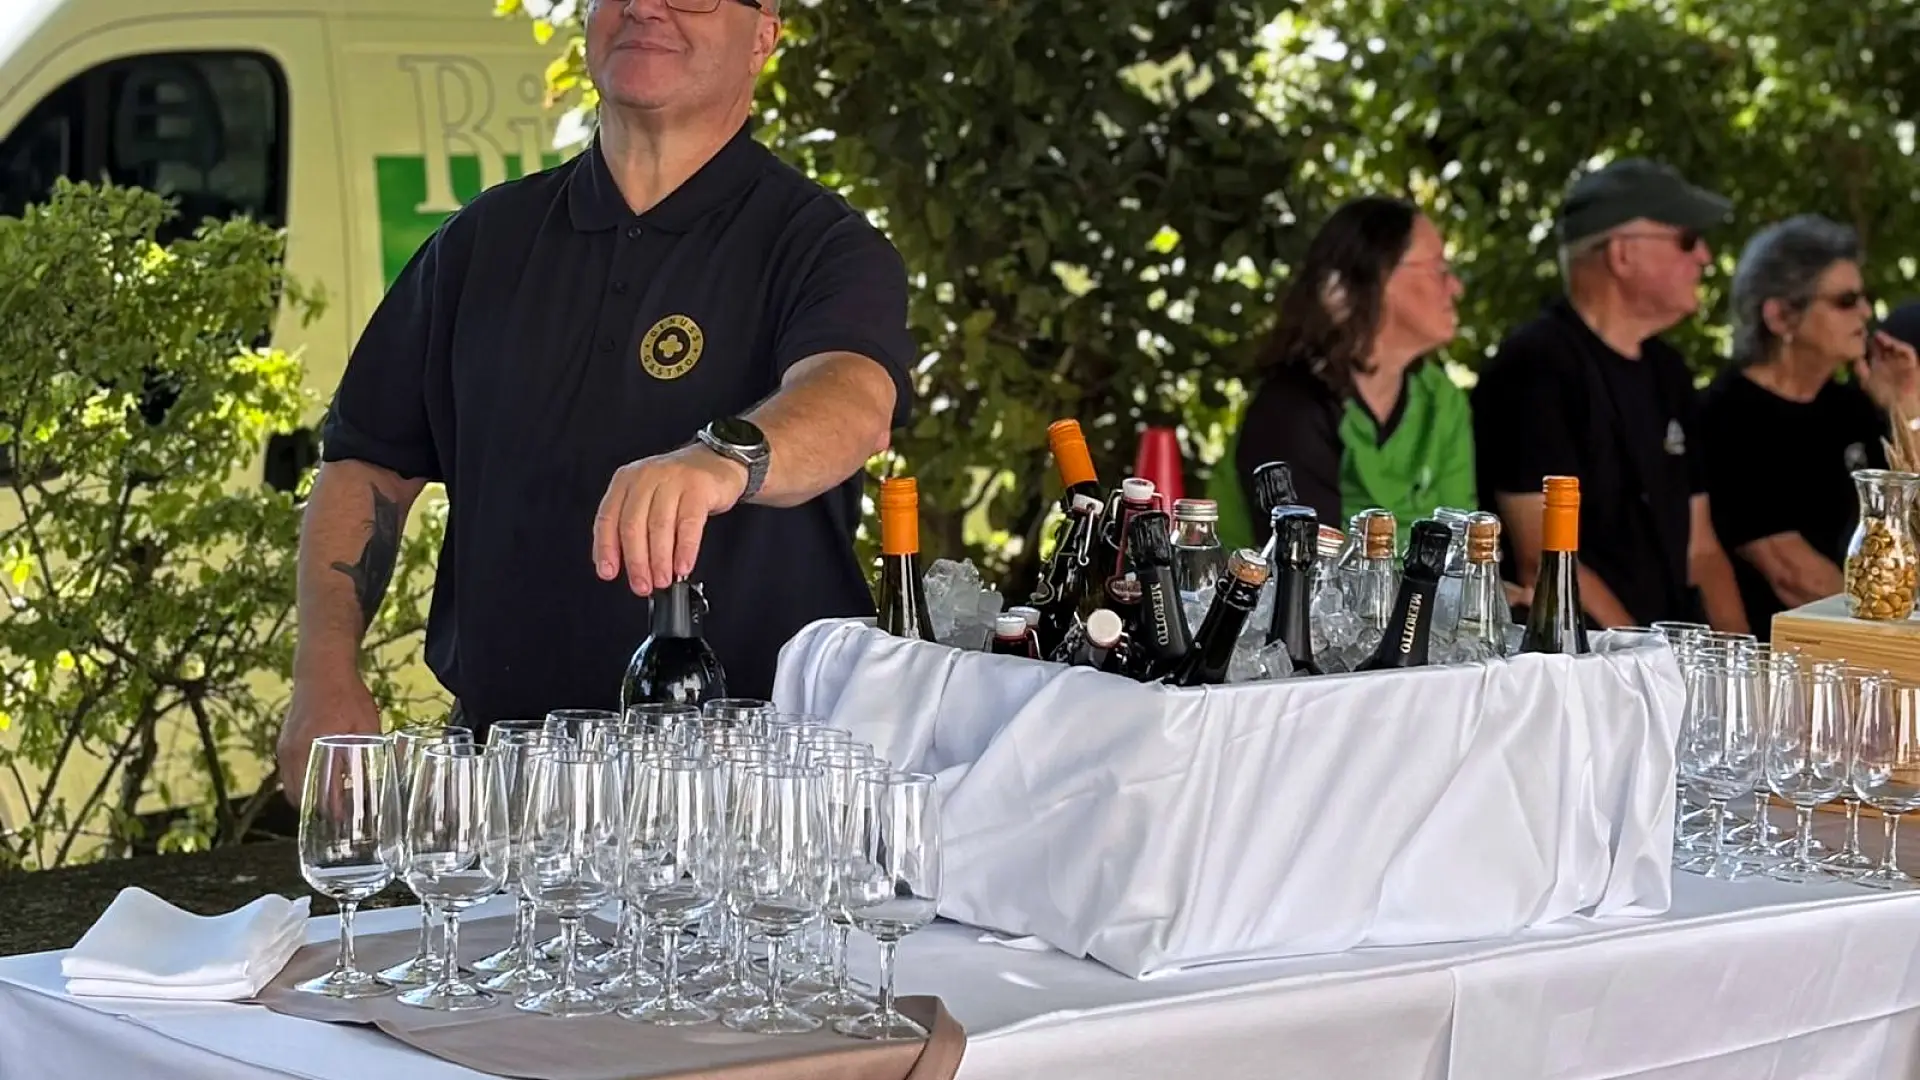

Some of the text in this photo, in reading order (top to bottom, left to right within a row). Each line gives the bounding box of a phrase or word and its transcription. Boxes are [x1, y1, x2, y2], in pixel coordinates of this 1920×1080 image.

[397, 54, 563, 214] Ri
[649, 318, 701, 342] GENUSS
[643, 355, 693, 376] GASTRO
[1150, 582, 1169, 646] MEROTTO
[1400, 593, 1422, 653] MEROTTO
